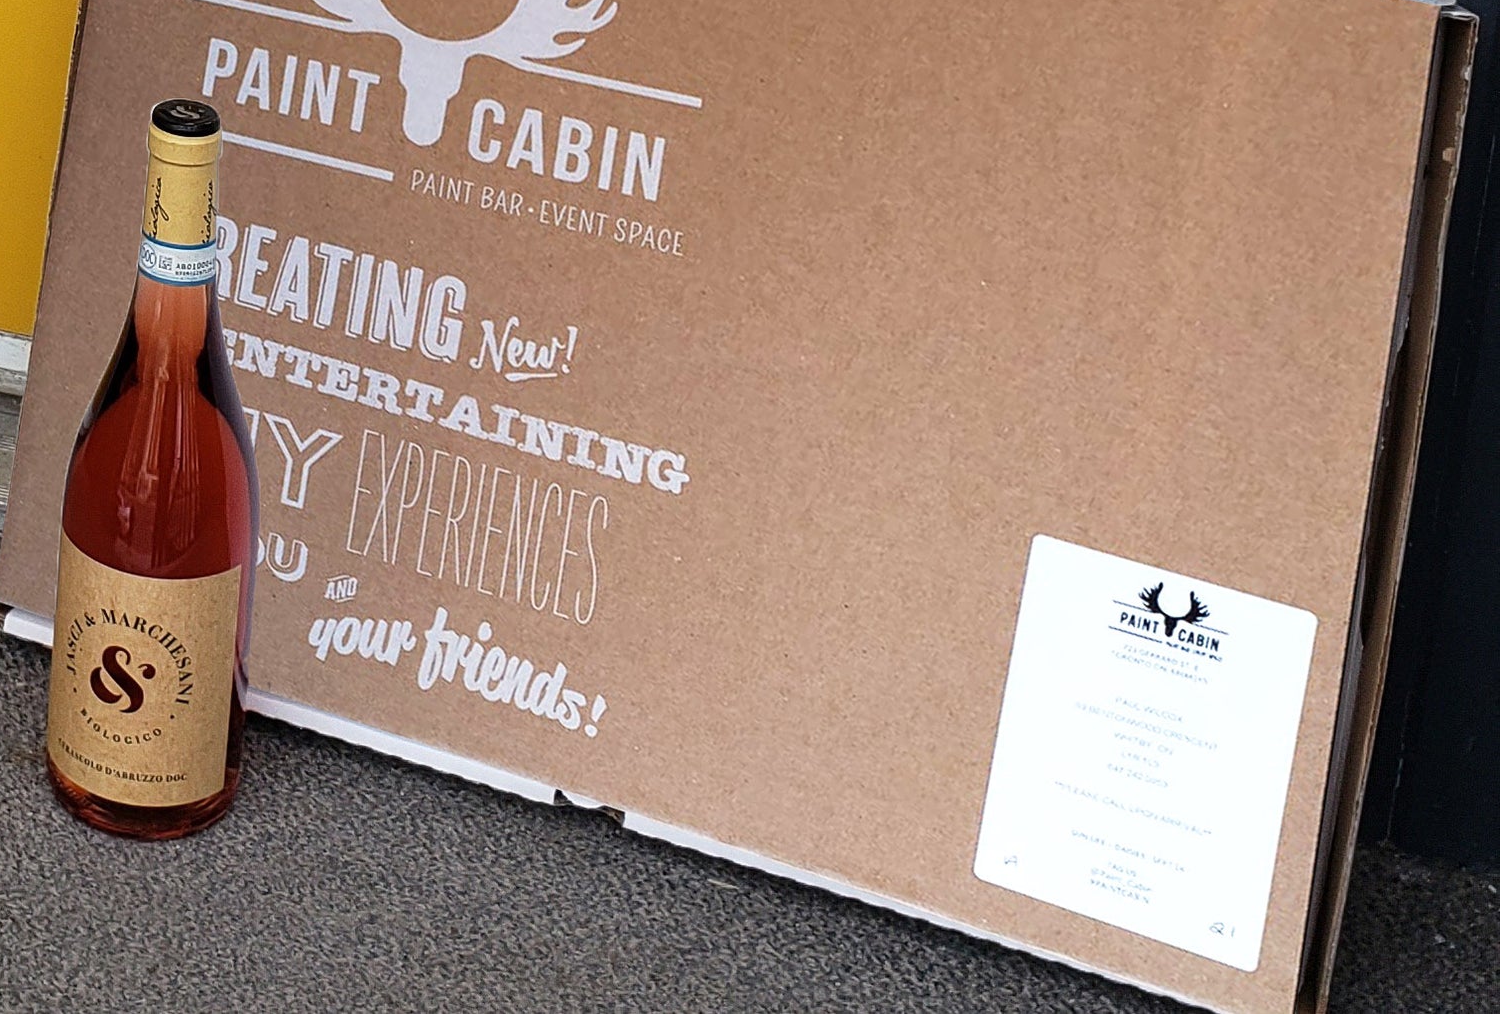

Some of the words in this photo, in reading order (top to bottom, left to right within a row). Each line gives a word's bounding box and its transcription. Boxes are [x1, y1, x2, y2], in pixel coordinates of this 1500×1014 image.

[201, 37, 381, 133] PAINT
[467, 98, 667, 202] CABIN
[410, 169, 475, 204] PAINT
[479, 186, 524, 217] BAR
[539, 200, 609, 237] EVENT
[613, 217, 685, 257] SPACE
[216, 214, 468, 364] REATING
[470, 314, 580, 383] New!
[346, 428, 610, 625] EXPERIENCES
[324, 577, 358, 602] AND
[1120, 611, 1160, 634] PAINT
[1178, 628, 1220, 652] CABIN
[101, 607, 195, 706] MARCHESANI
[308, 616, 417, 667] your
[417, 606, 608, 738] friends!
